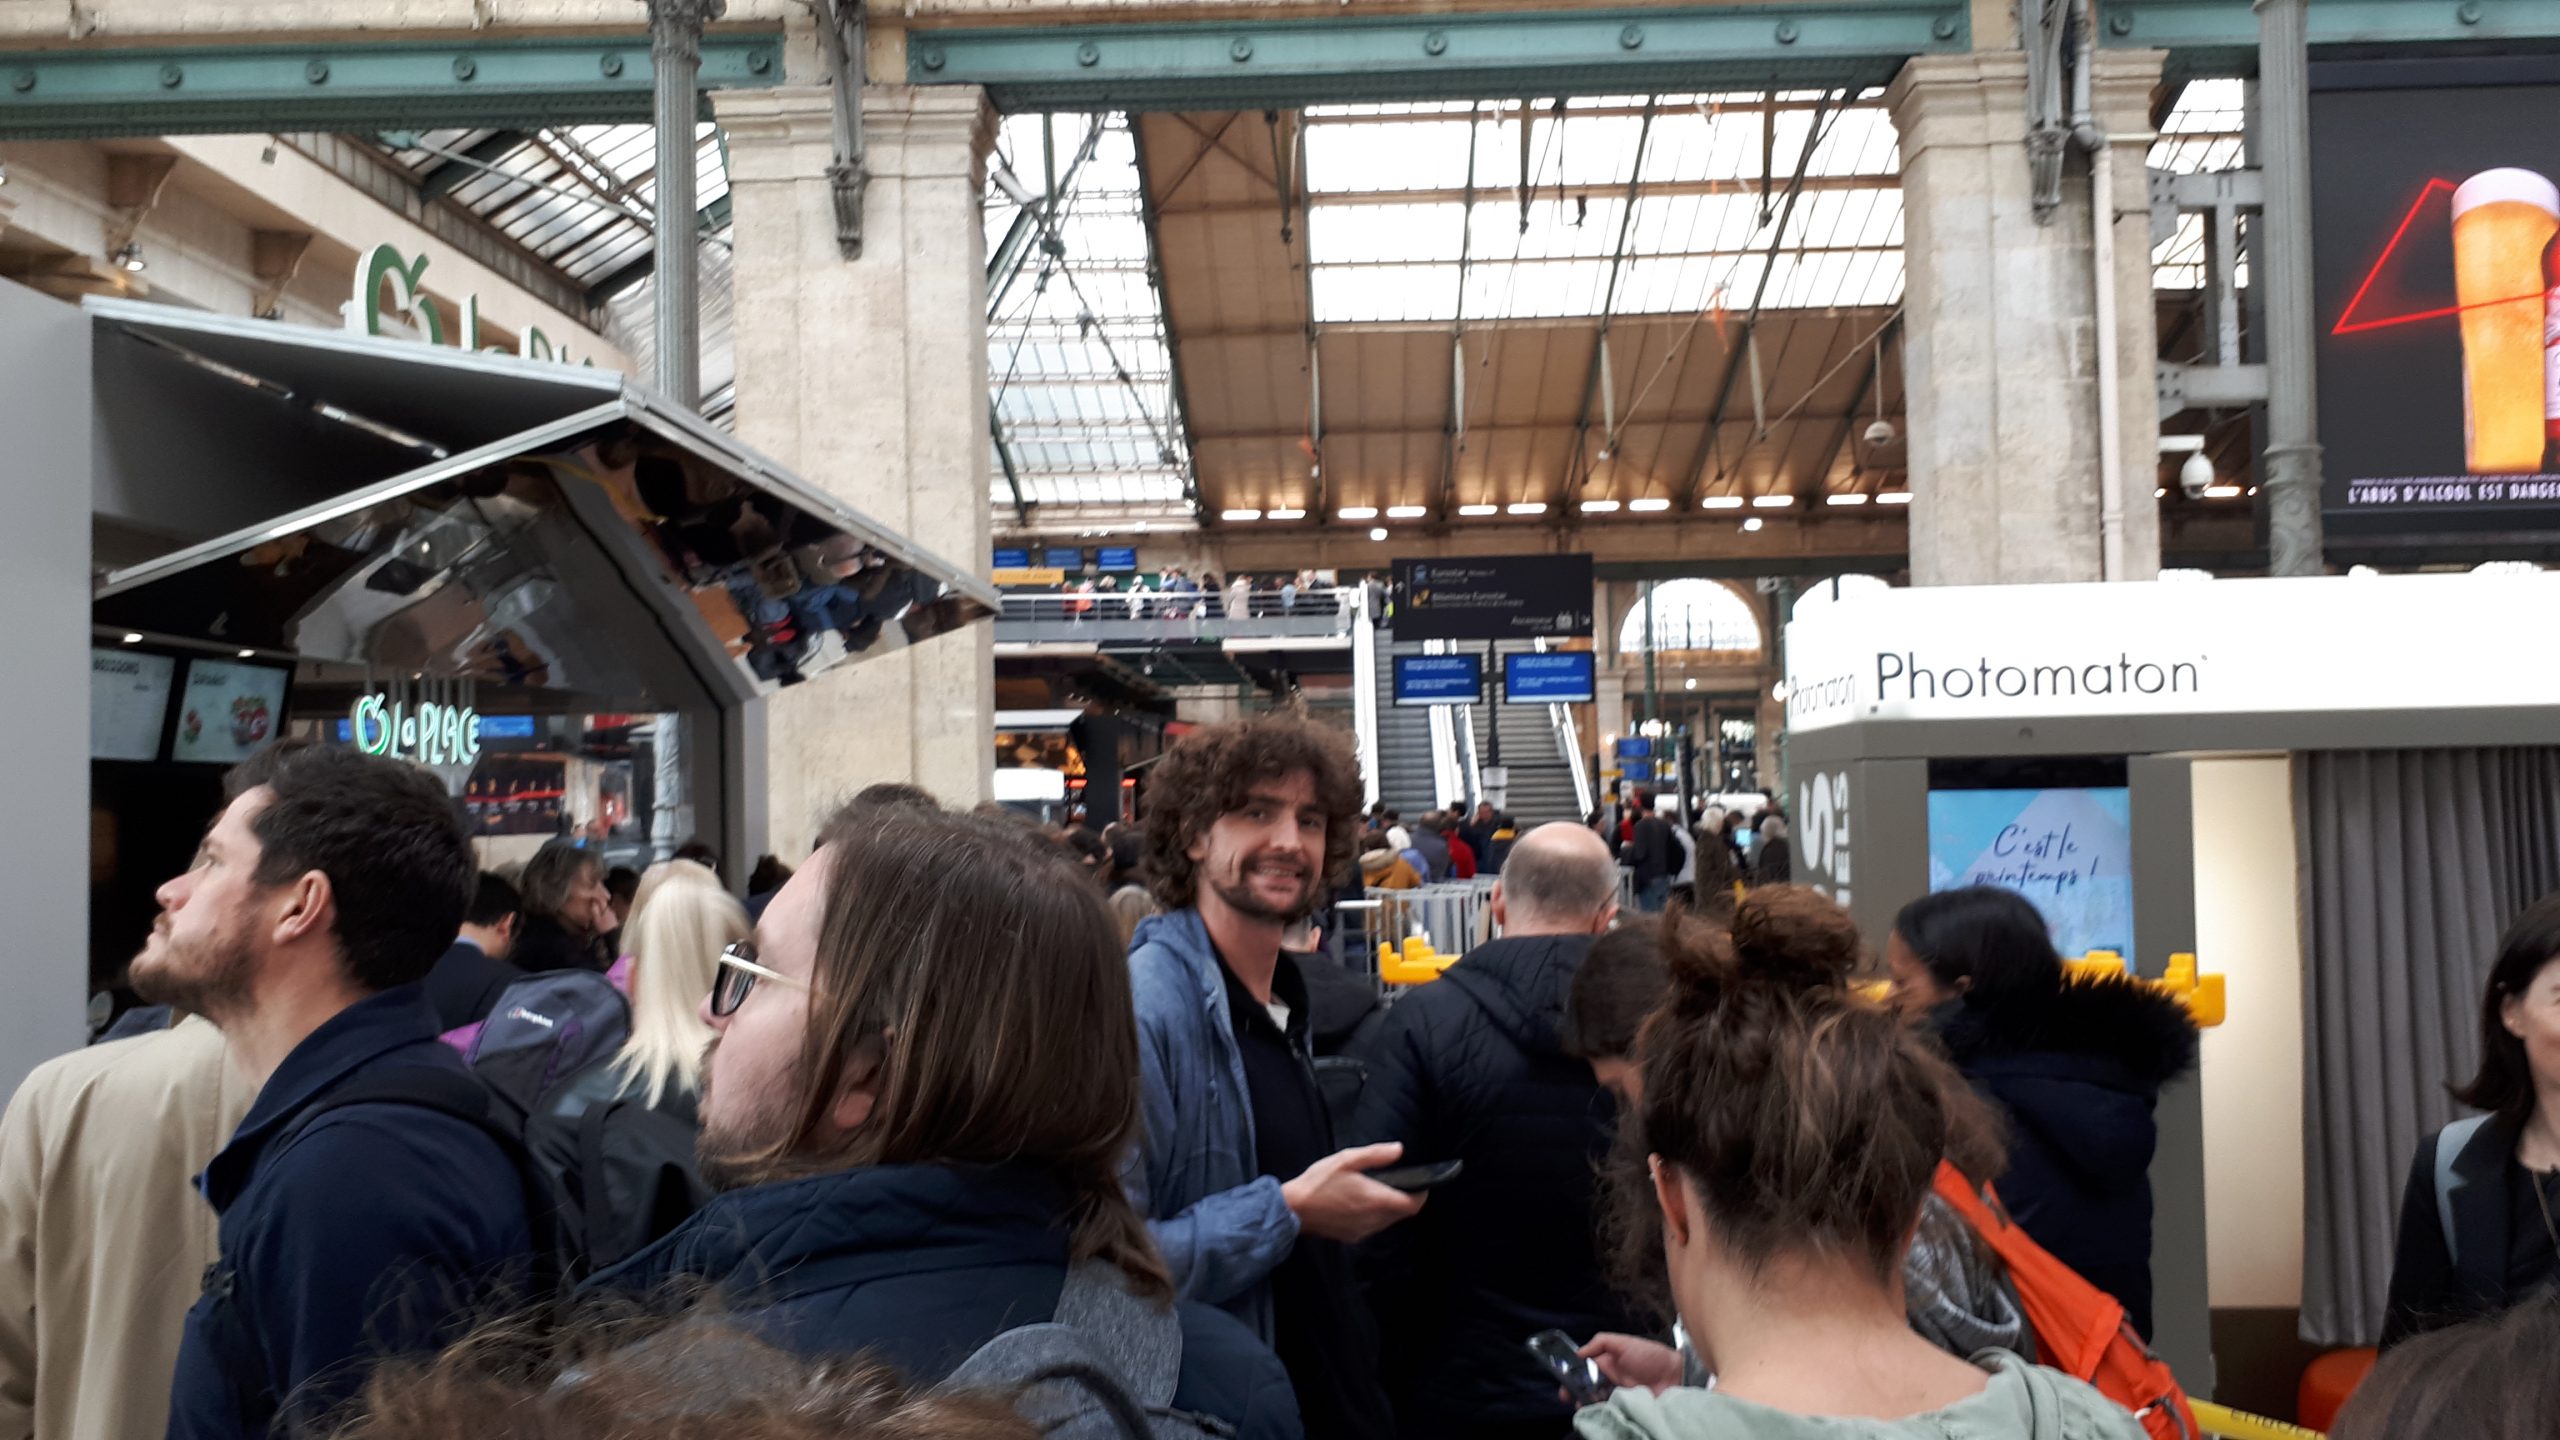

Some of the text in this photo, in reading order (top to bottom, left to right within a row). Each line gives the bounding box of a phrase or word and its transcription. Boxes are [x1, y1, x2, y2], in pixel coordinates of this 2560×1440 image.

[2403, 484, 2472, 503] D'ALCOOL
[2478, 483, 2503, 500] EST
[1877, 651, 2198, 700] Photomaton
[419, 701, 481, 766] PLACE
[2057, 821, 2079, 861] le
